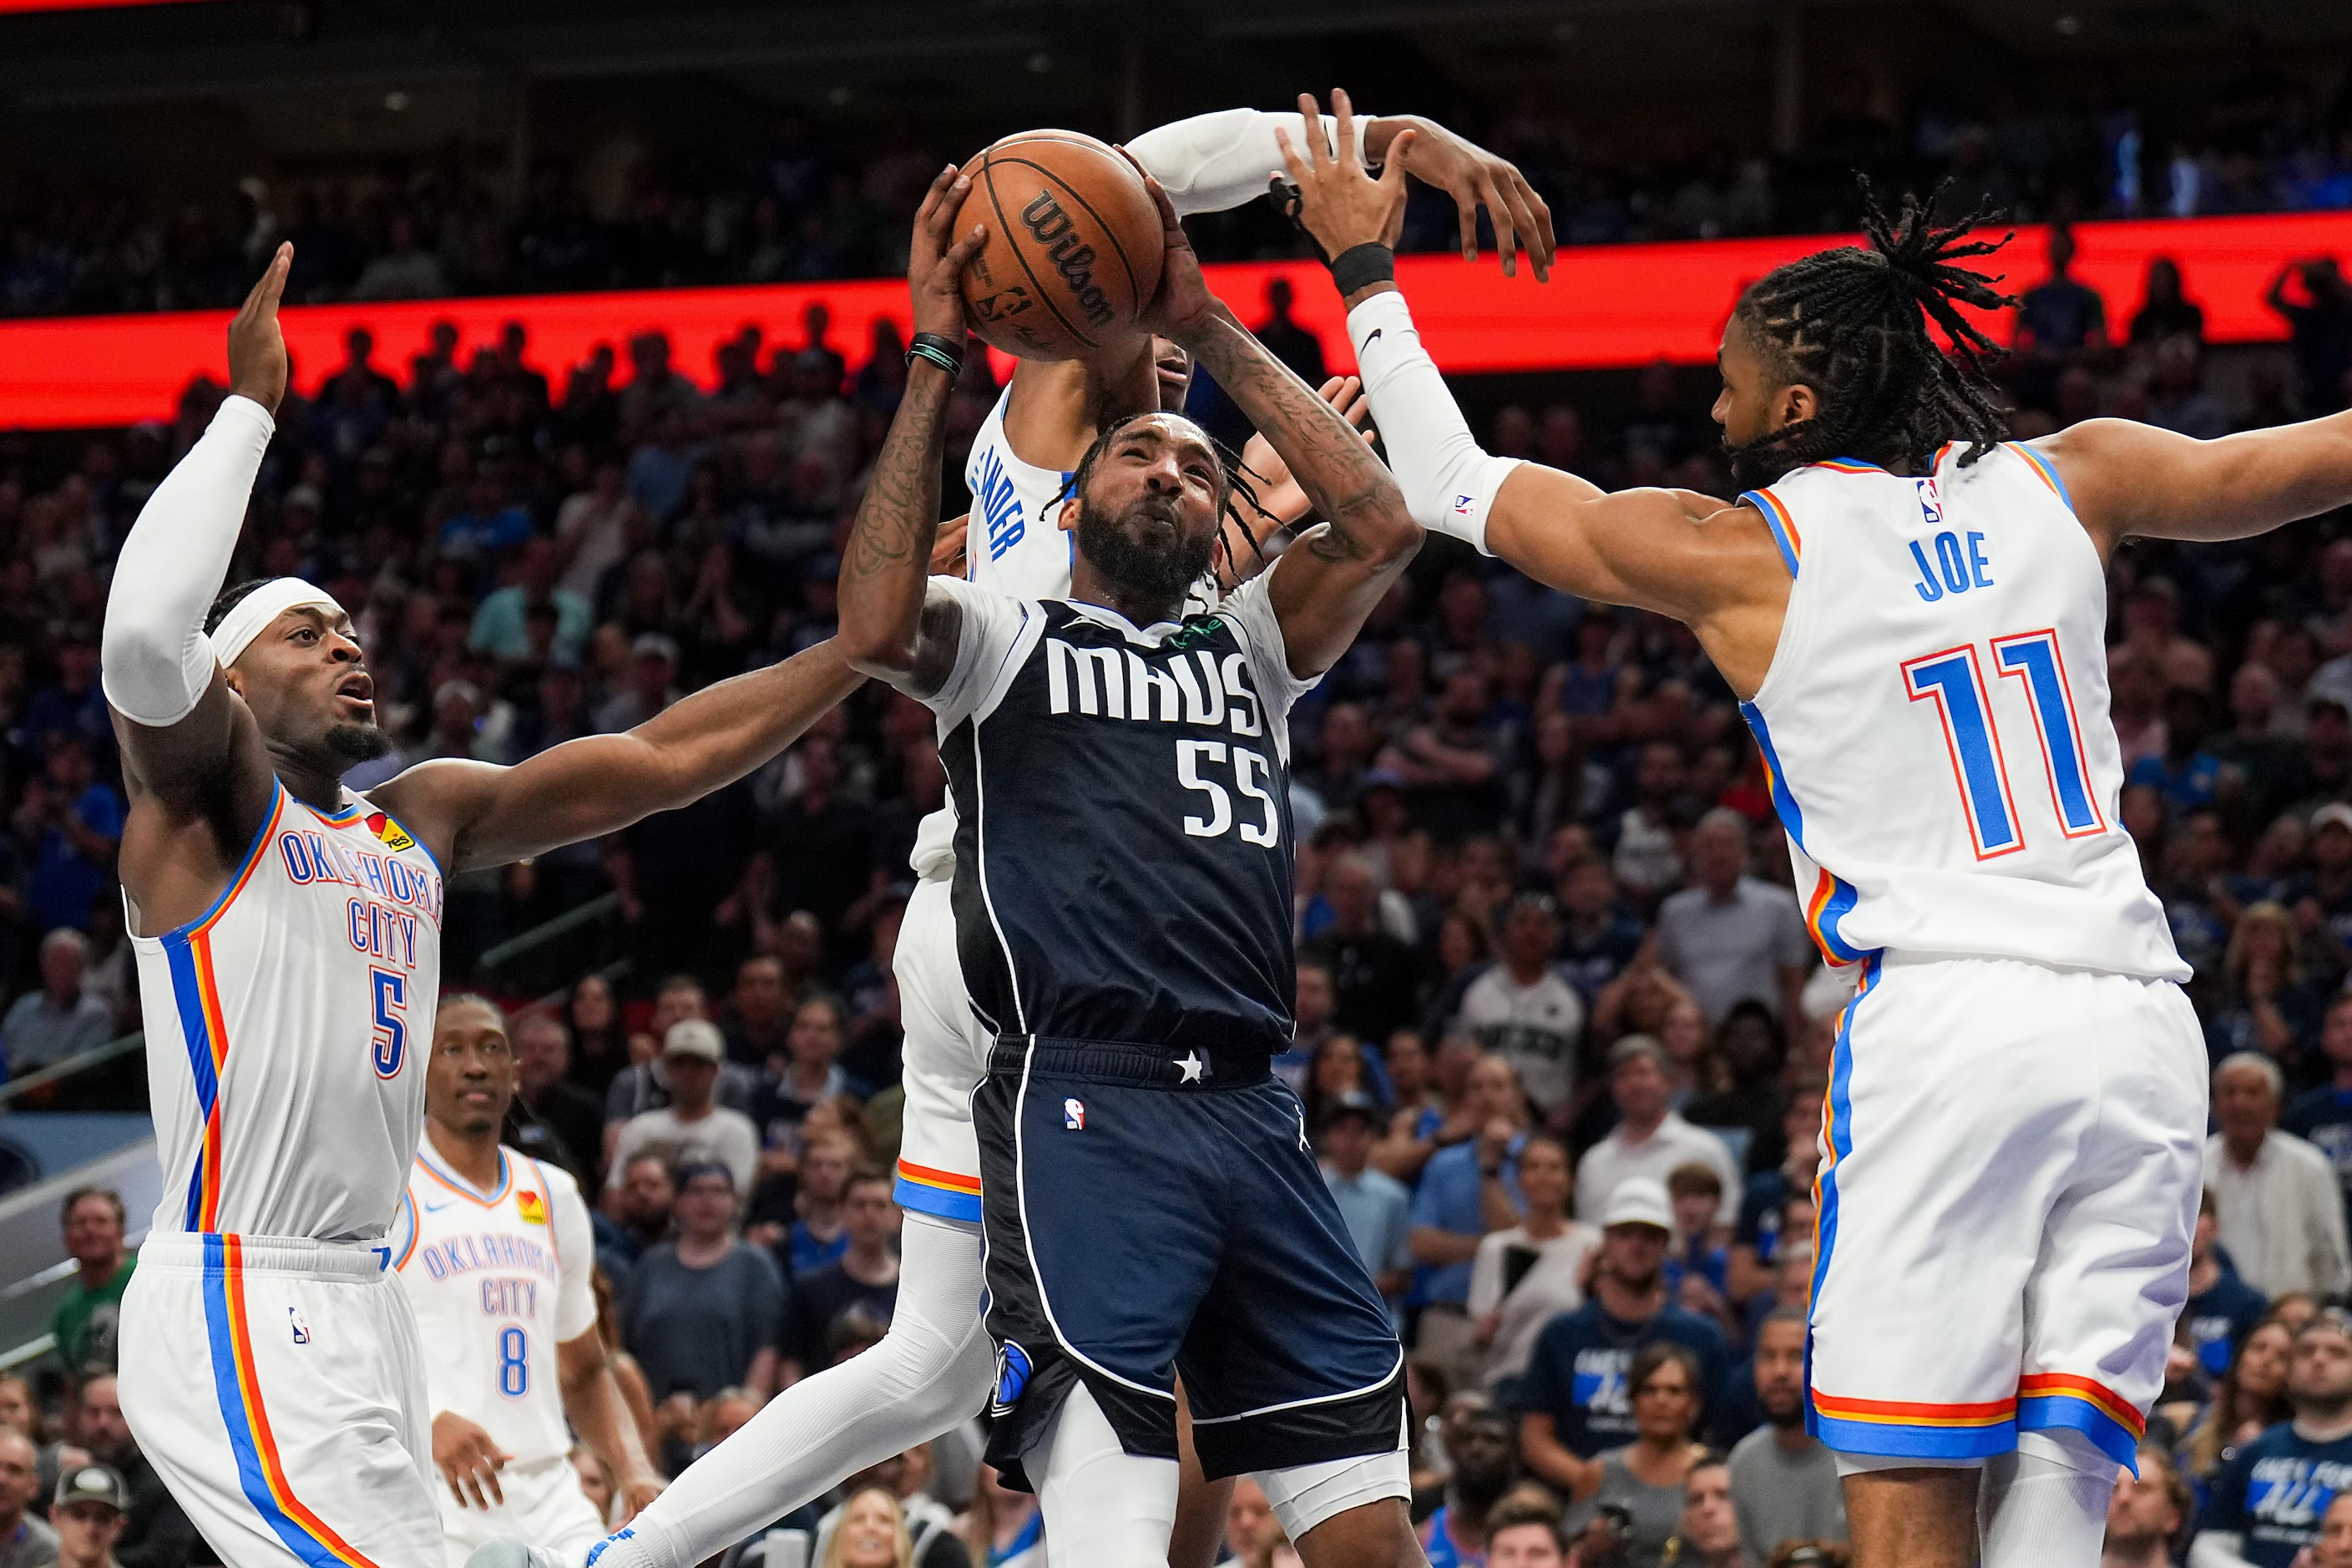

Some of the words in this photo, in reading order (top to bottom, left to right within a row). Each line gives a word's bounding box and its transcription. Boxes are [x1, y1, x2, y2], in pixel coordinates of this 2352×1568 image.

[1020, 189, 1115, 327] Wilson
[1909, 530, 1995, 602] JOE
[1046, 637, 1262, 737] MAVS
[1899, 628, 2107, 861] 11
[1176, 740, 1278, 848] 55
[347, 897, 417, 969] CITY
[369, 964, 407, 1080] 5
[419, 1231, 559, 1288] OKLAHOMA
[478, 1277, 537, 1319] CITY
[495, 1322, 530, 1403] 8
